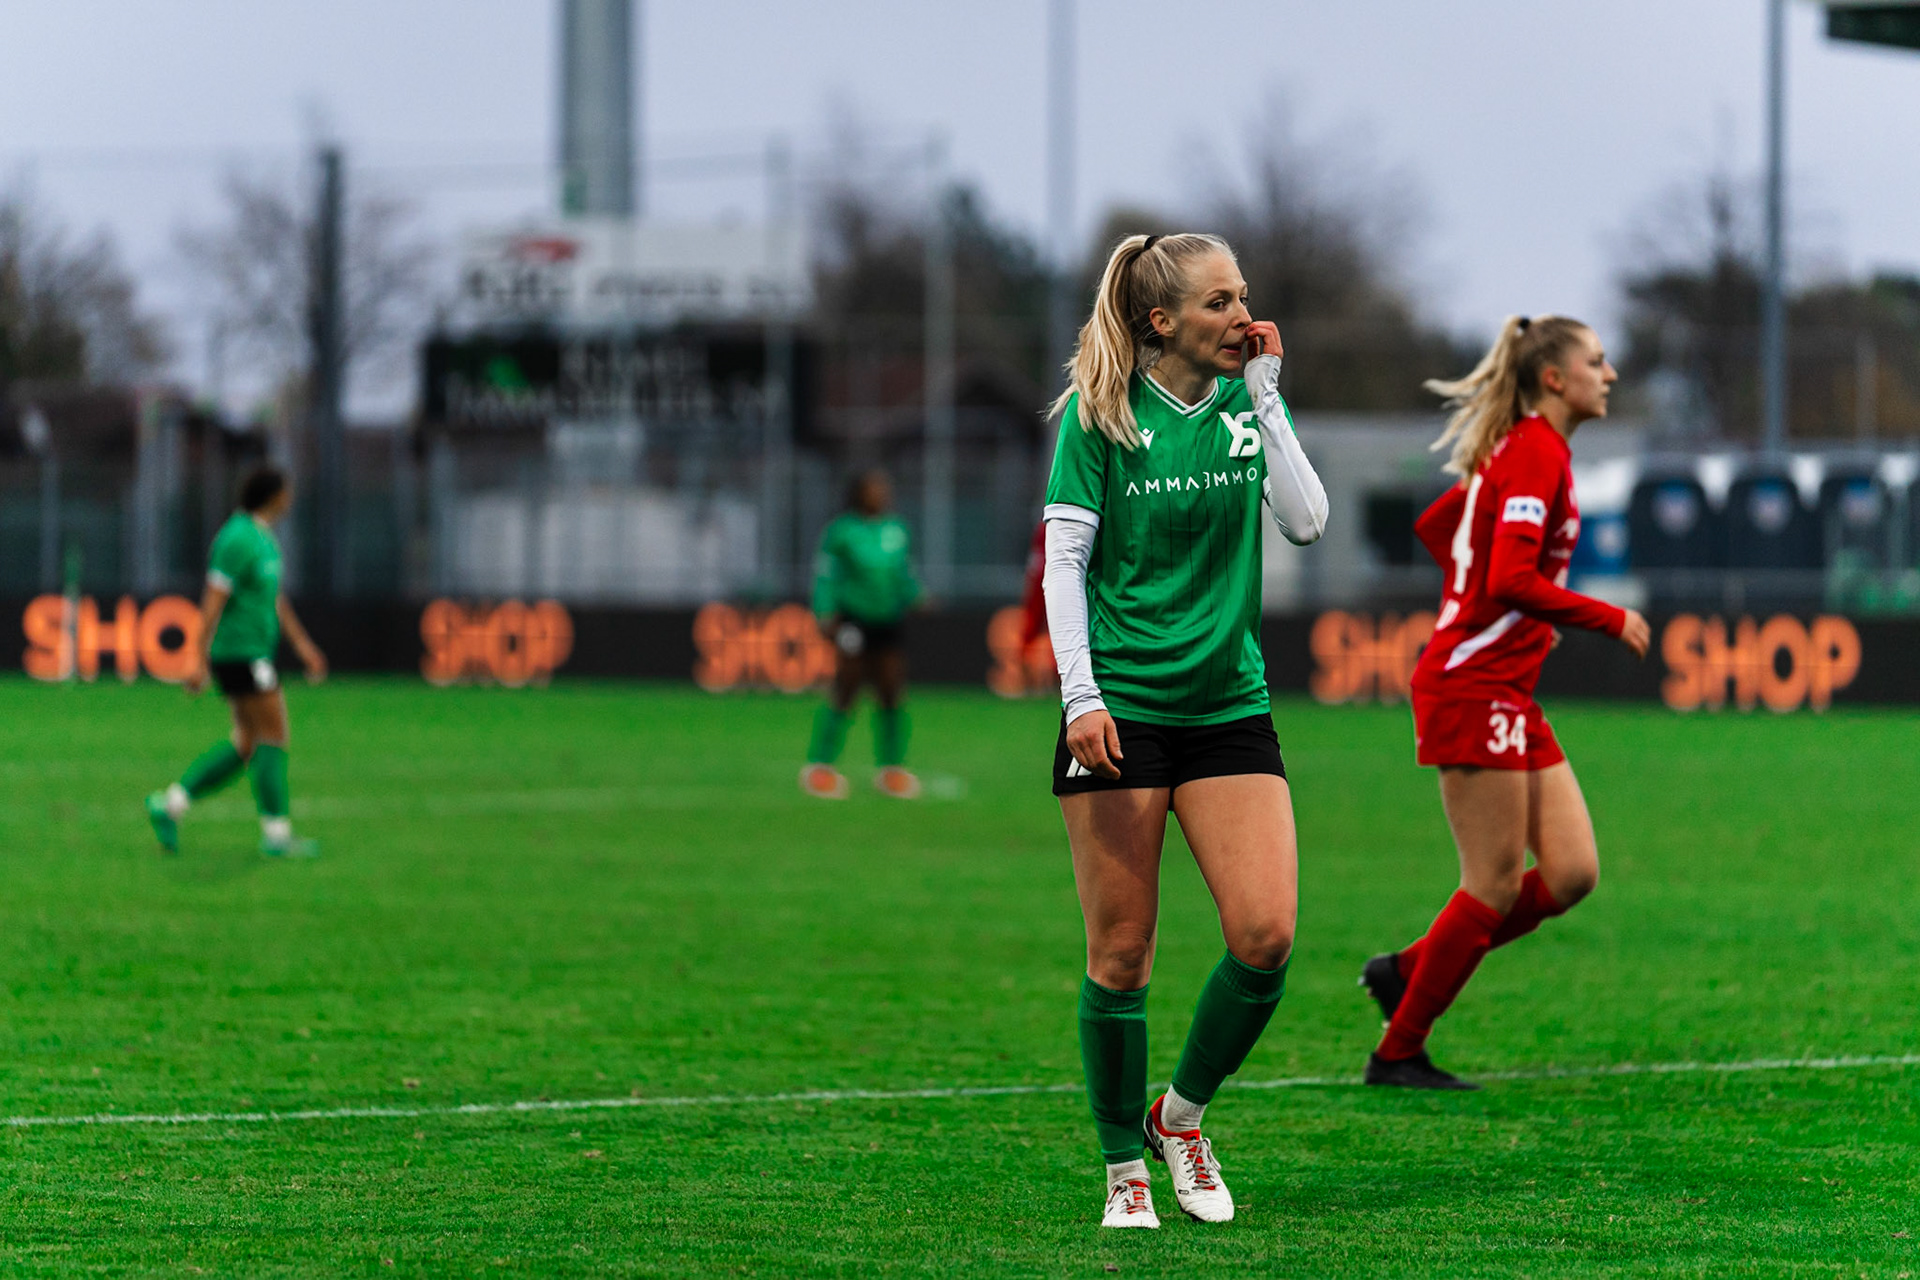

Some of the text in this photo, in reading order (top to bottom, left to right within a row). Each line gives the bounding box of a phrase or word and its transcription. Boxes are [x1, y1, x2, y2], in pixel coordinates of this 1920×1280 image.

[23, 594, 202, 682] SHO
[420, 598, 575, 688] SHOP
[1310, 610, 1437, 706] SHO
[1661, 613, 1862, 713] SHOP
[1487, 712, 1527, 756] 34
